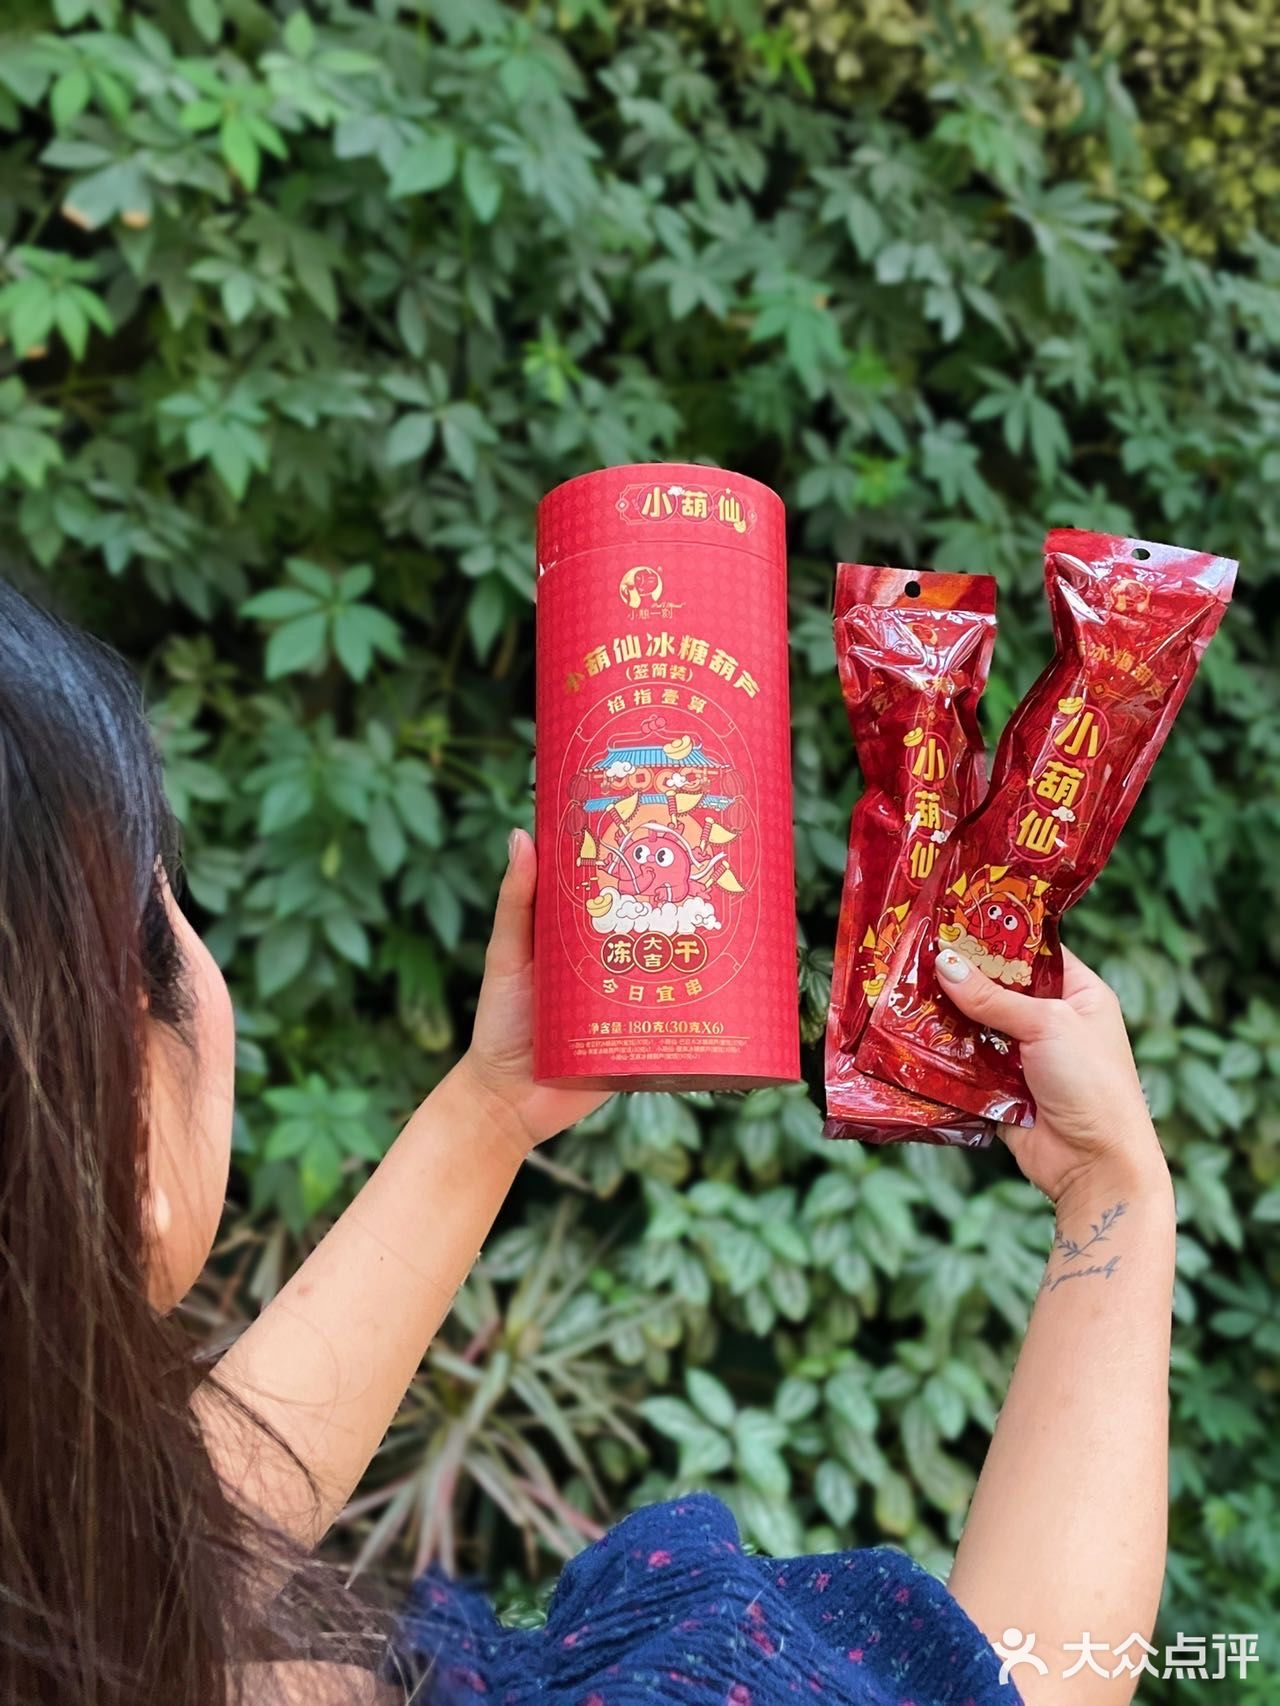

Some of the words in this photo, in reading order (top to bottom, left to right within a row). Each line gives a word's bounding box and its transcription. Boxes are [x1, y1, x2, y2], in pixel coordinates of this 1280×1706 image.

[640, 486, 742, 524] 小葫仙
[606, 688, 708, 715] 掐指壹算
[1014, 712, 1099, 855] 小葫仙
[909, 741, 946, 879] 小葫仙
[602, 978, 703, 1003] 今日宜串
